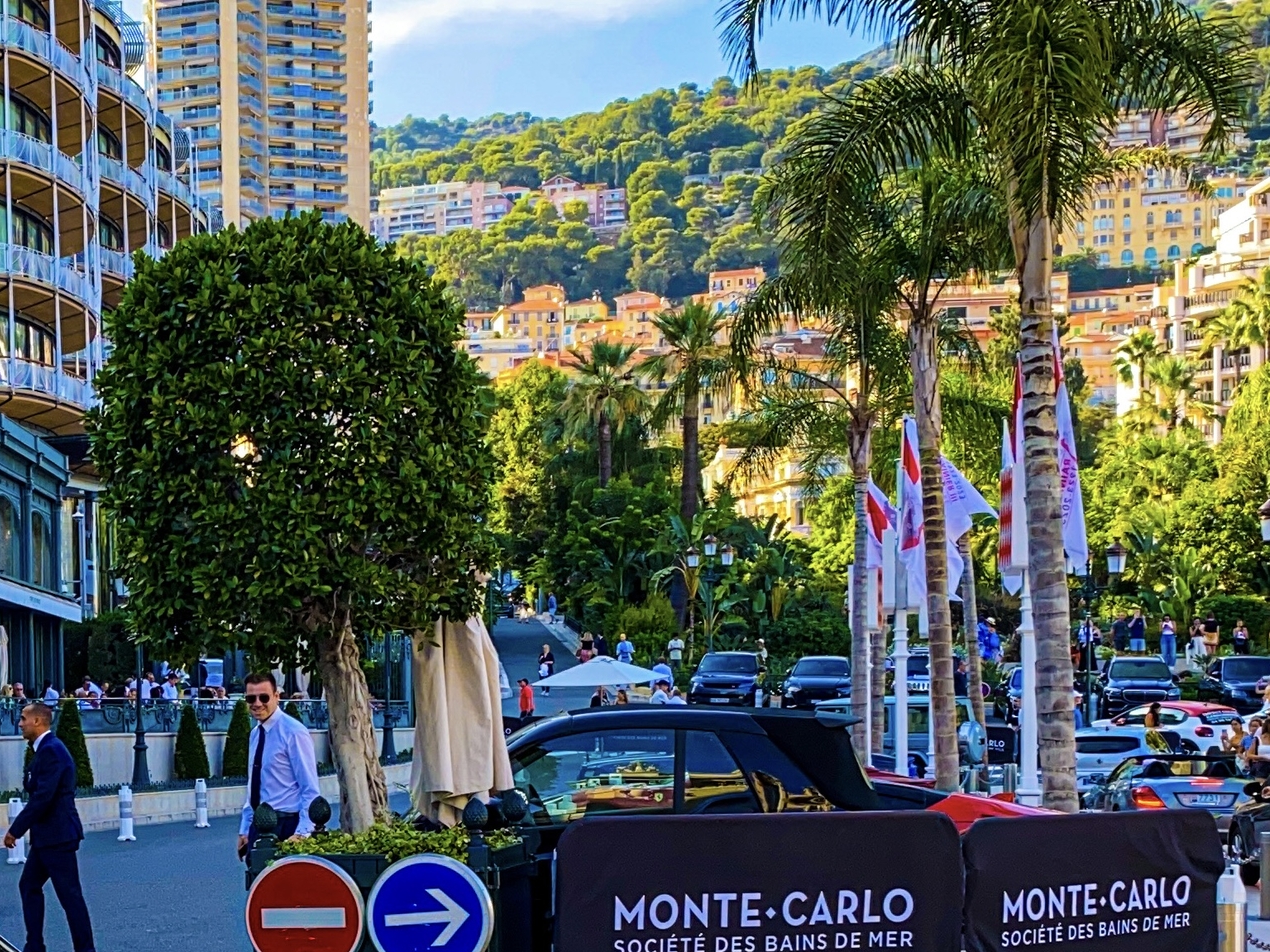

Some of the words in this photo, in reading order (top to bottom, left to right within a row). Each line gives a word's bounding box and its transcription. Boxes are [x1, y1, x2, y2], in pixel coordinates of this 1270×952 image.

[715, 935, 756, 952] DES
[764, 932, 828, 952] BAINS
[834, 931, 862, 949] DE
[868, 930, 914, 948] MER
[1001, 922, 1064, 947] SOCIÉTÉ
[1068, 922, 1094, 941] DES
[1098, 918, 1139, 937] BAINS
[1142, 915, 1161, 932] DE
[1163, 912, 1191, 930] MER
